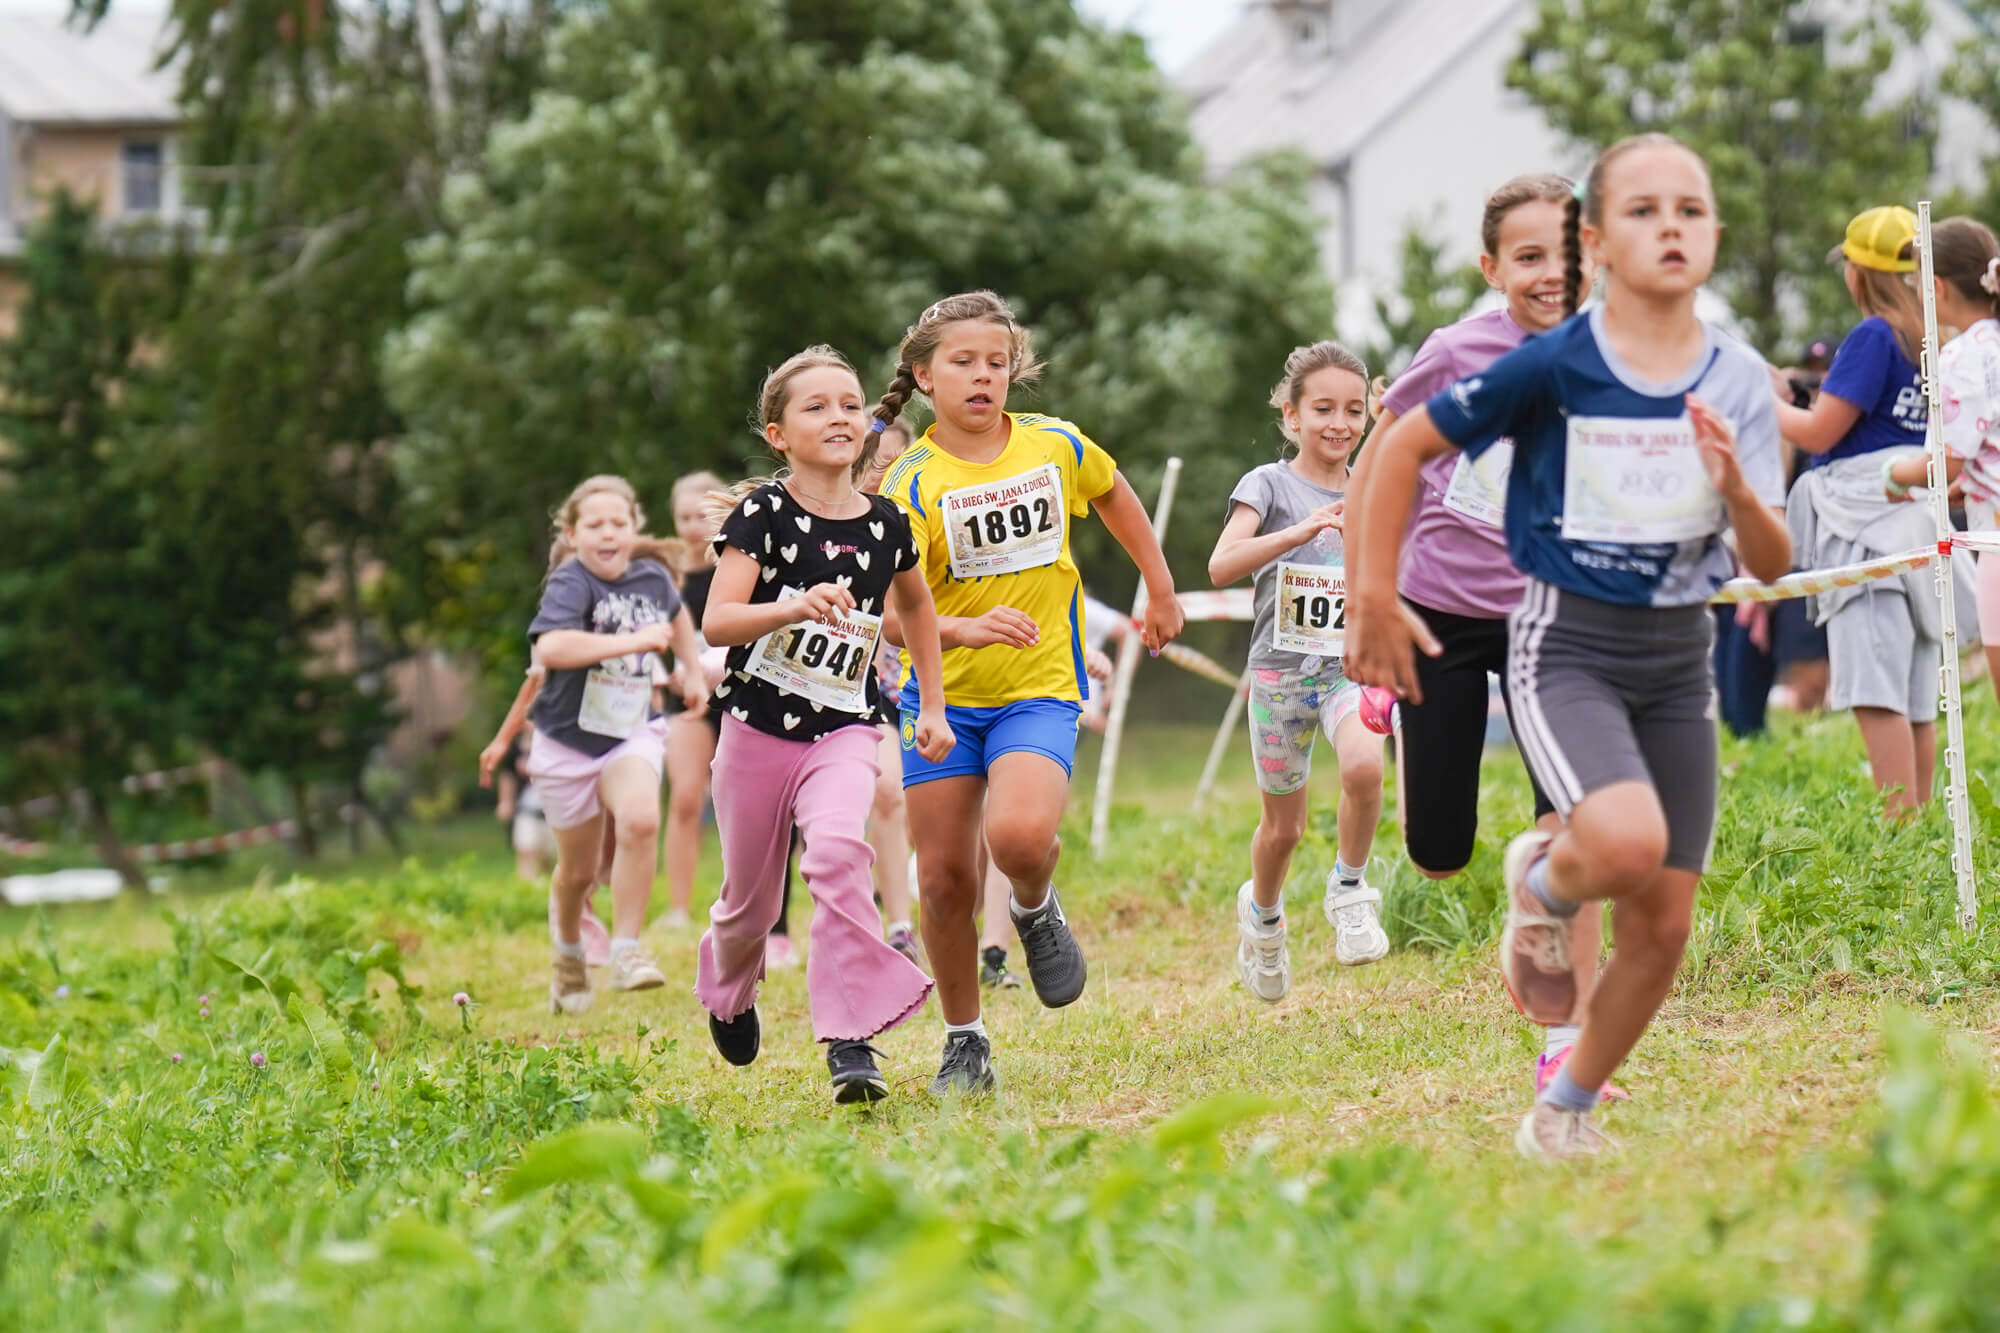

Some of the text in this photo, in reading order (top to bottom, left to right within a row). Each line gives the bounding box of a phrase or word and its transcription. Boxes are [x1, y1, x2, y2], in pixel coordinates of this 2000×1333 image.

[951, 497, 961, 511] IX
[962, 495, 983, 509] BIEG
[984, 490, 1001, 504] ŚW.
[1001, 484, 1023, 503] JANA
[1023, 483, 1029, 494] Z
[1028, 475, 1050, 491] DUKLI
[964, 497, 1053, 549] 1892
[1285, 575, 1294, 586] IX
[1295, 576, 1315, 588] BIEG
[1316, 575, 1331, 589] ŚW.
[1291, 595, 1345, 630] 192
[784, 628, 864, 681] 1948
